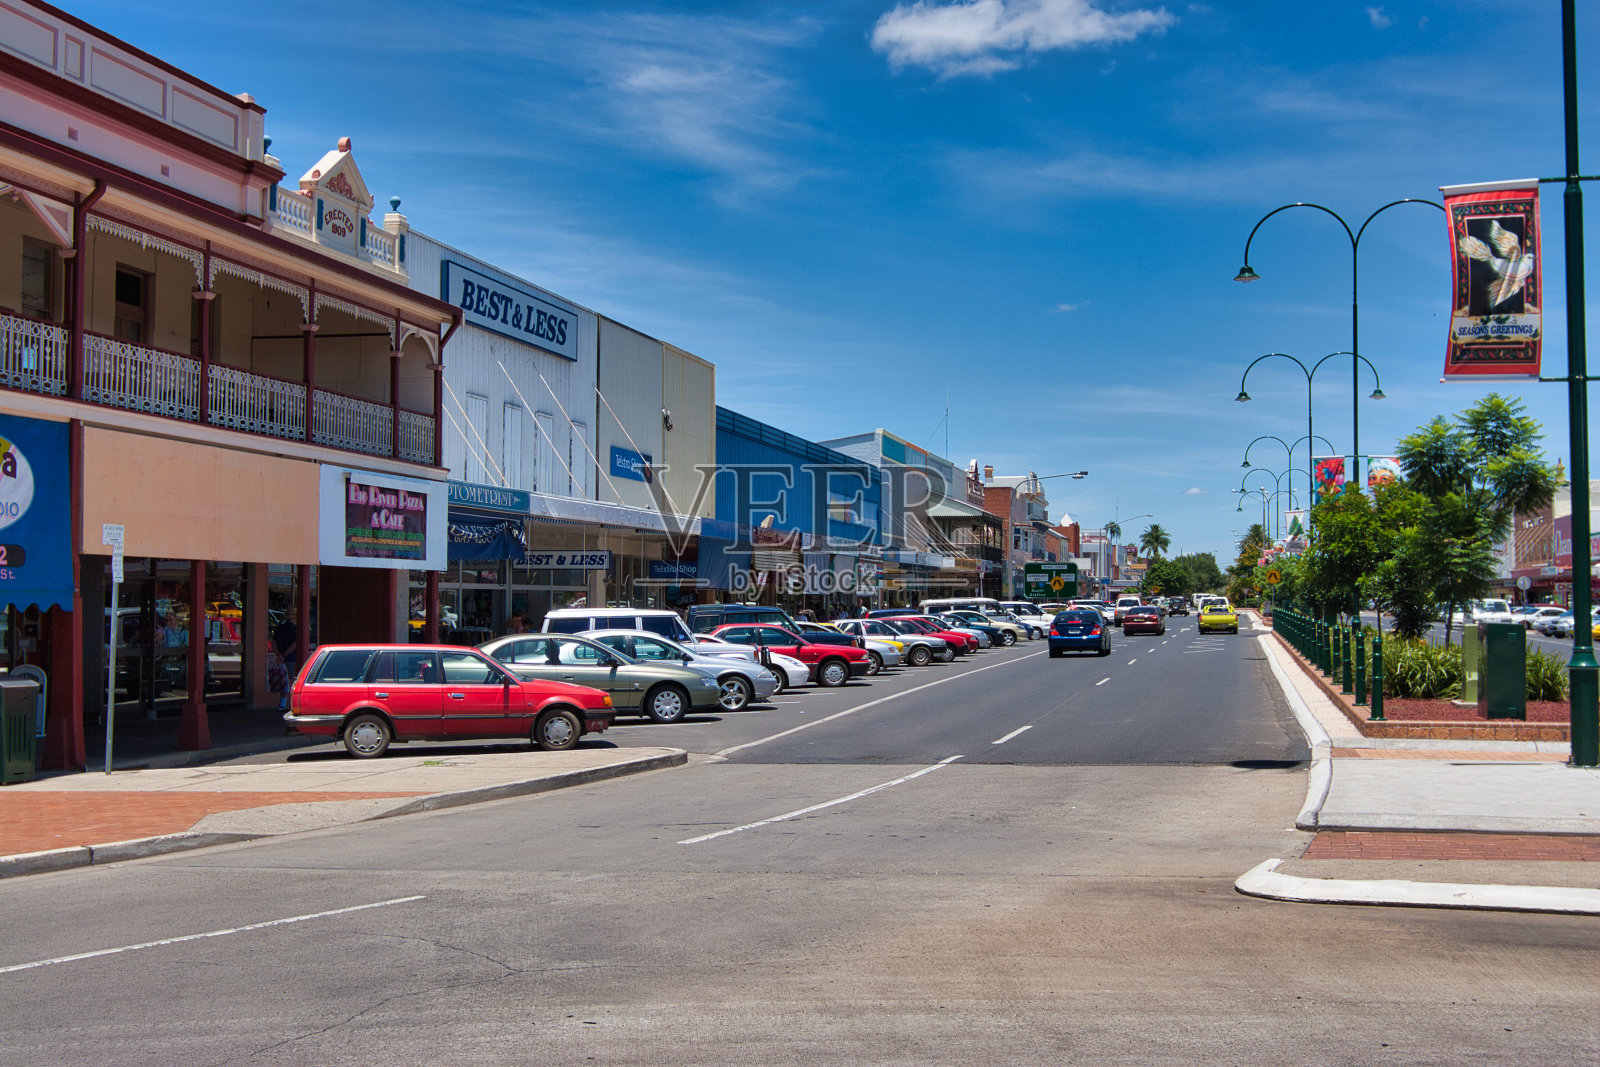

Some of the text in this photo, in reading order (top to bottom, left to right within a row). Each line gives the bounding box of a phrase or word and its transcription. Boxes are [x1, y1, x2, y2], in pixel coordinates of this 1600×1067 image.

[324, 209, 354, 233] ERECTED
[331, 222, 346, 238] 1909
[460, 279, 568, 346] BEST & LESS
[1490, 324, 1533, 335] GREETINGS
[615, 454, 631, 469] Telstra
[371, 511, 380, 528] &
[556, 554, 566, 566] &
[569, 554, 607, 566] LESS
[654, 565, 697, 575] Telstra Shop
[677, 594, 695, 605] SALE
